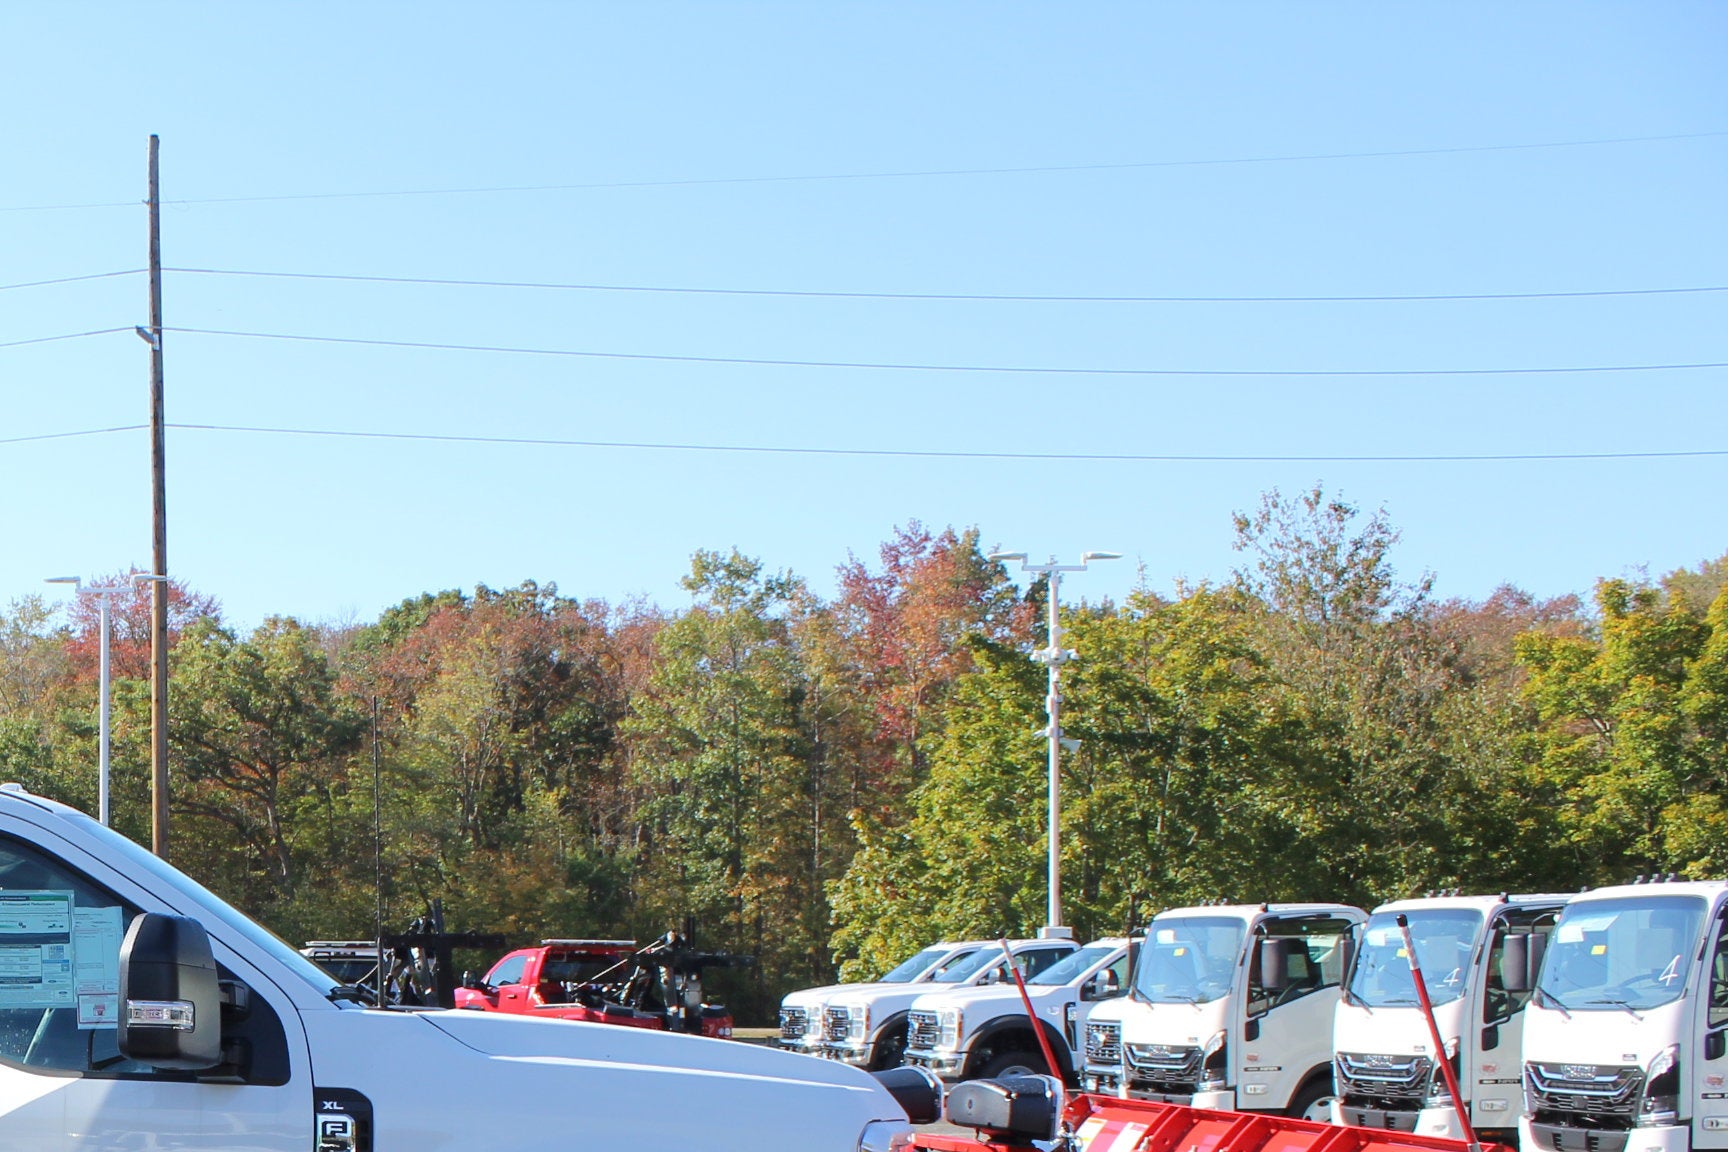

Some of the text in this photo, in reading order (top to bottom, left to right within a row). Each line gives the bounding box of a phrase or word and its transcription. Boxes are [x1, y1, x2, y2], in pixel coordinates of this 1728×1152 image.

[1442, 967, 1461, 987] 4
[1658, 954, 1681, 987] 4
[322, 1101, 344, 1110] XL
